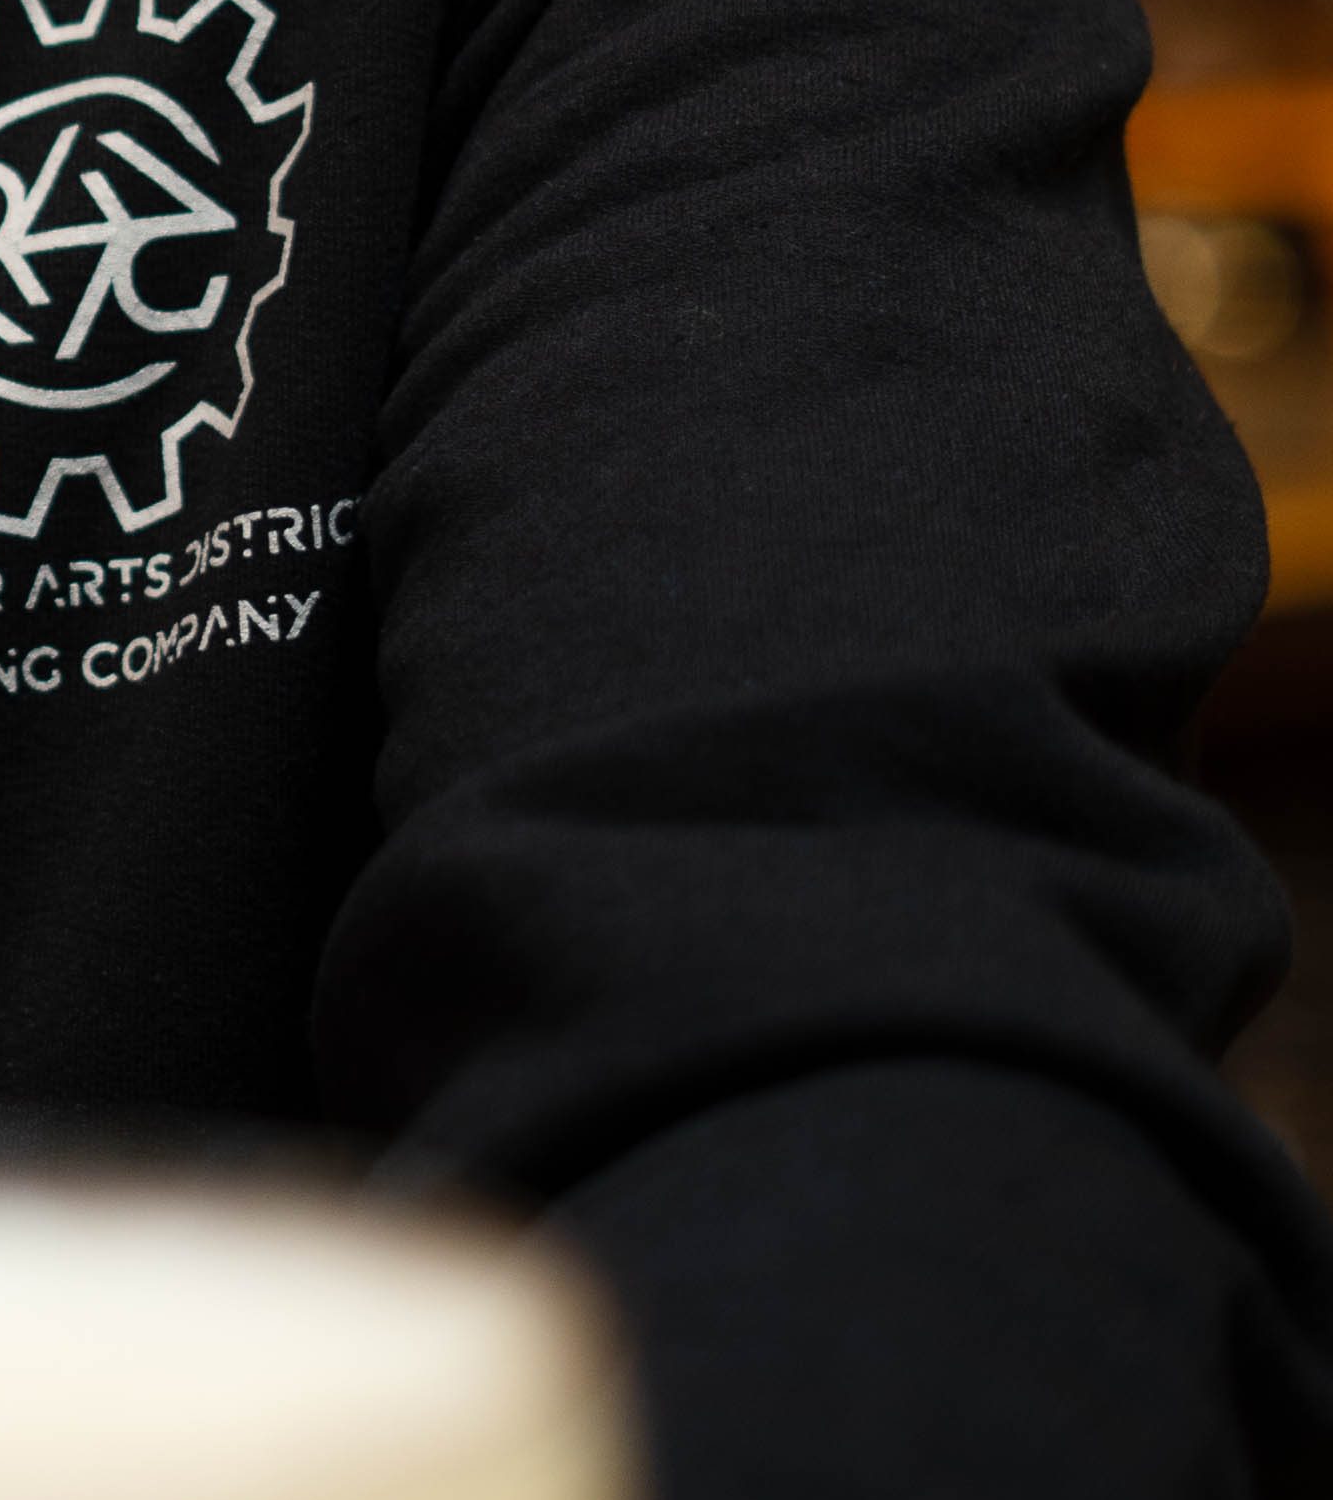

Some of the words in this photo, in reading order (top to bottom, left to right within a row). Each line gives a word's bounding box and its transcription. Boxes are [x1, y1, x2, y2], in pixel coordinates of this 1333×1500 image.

[25, 552, 173, 610] ARTS
[179, 498, 361, 587] DISTRIC
[81, 590, 321, 688] COMPANY
